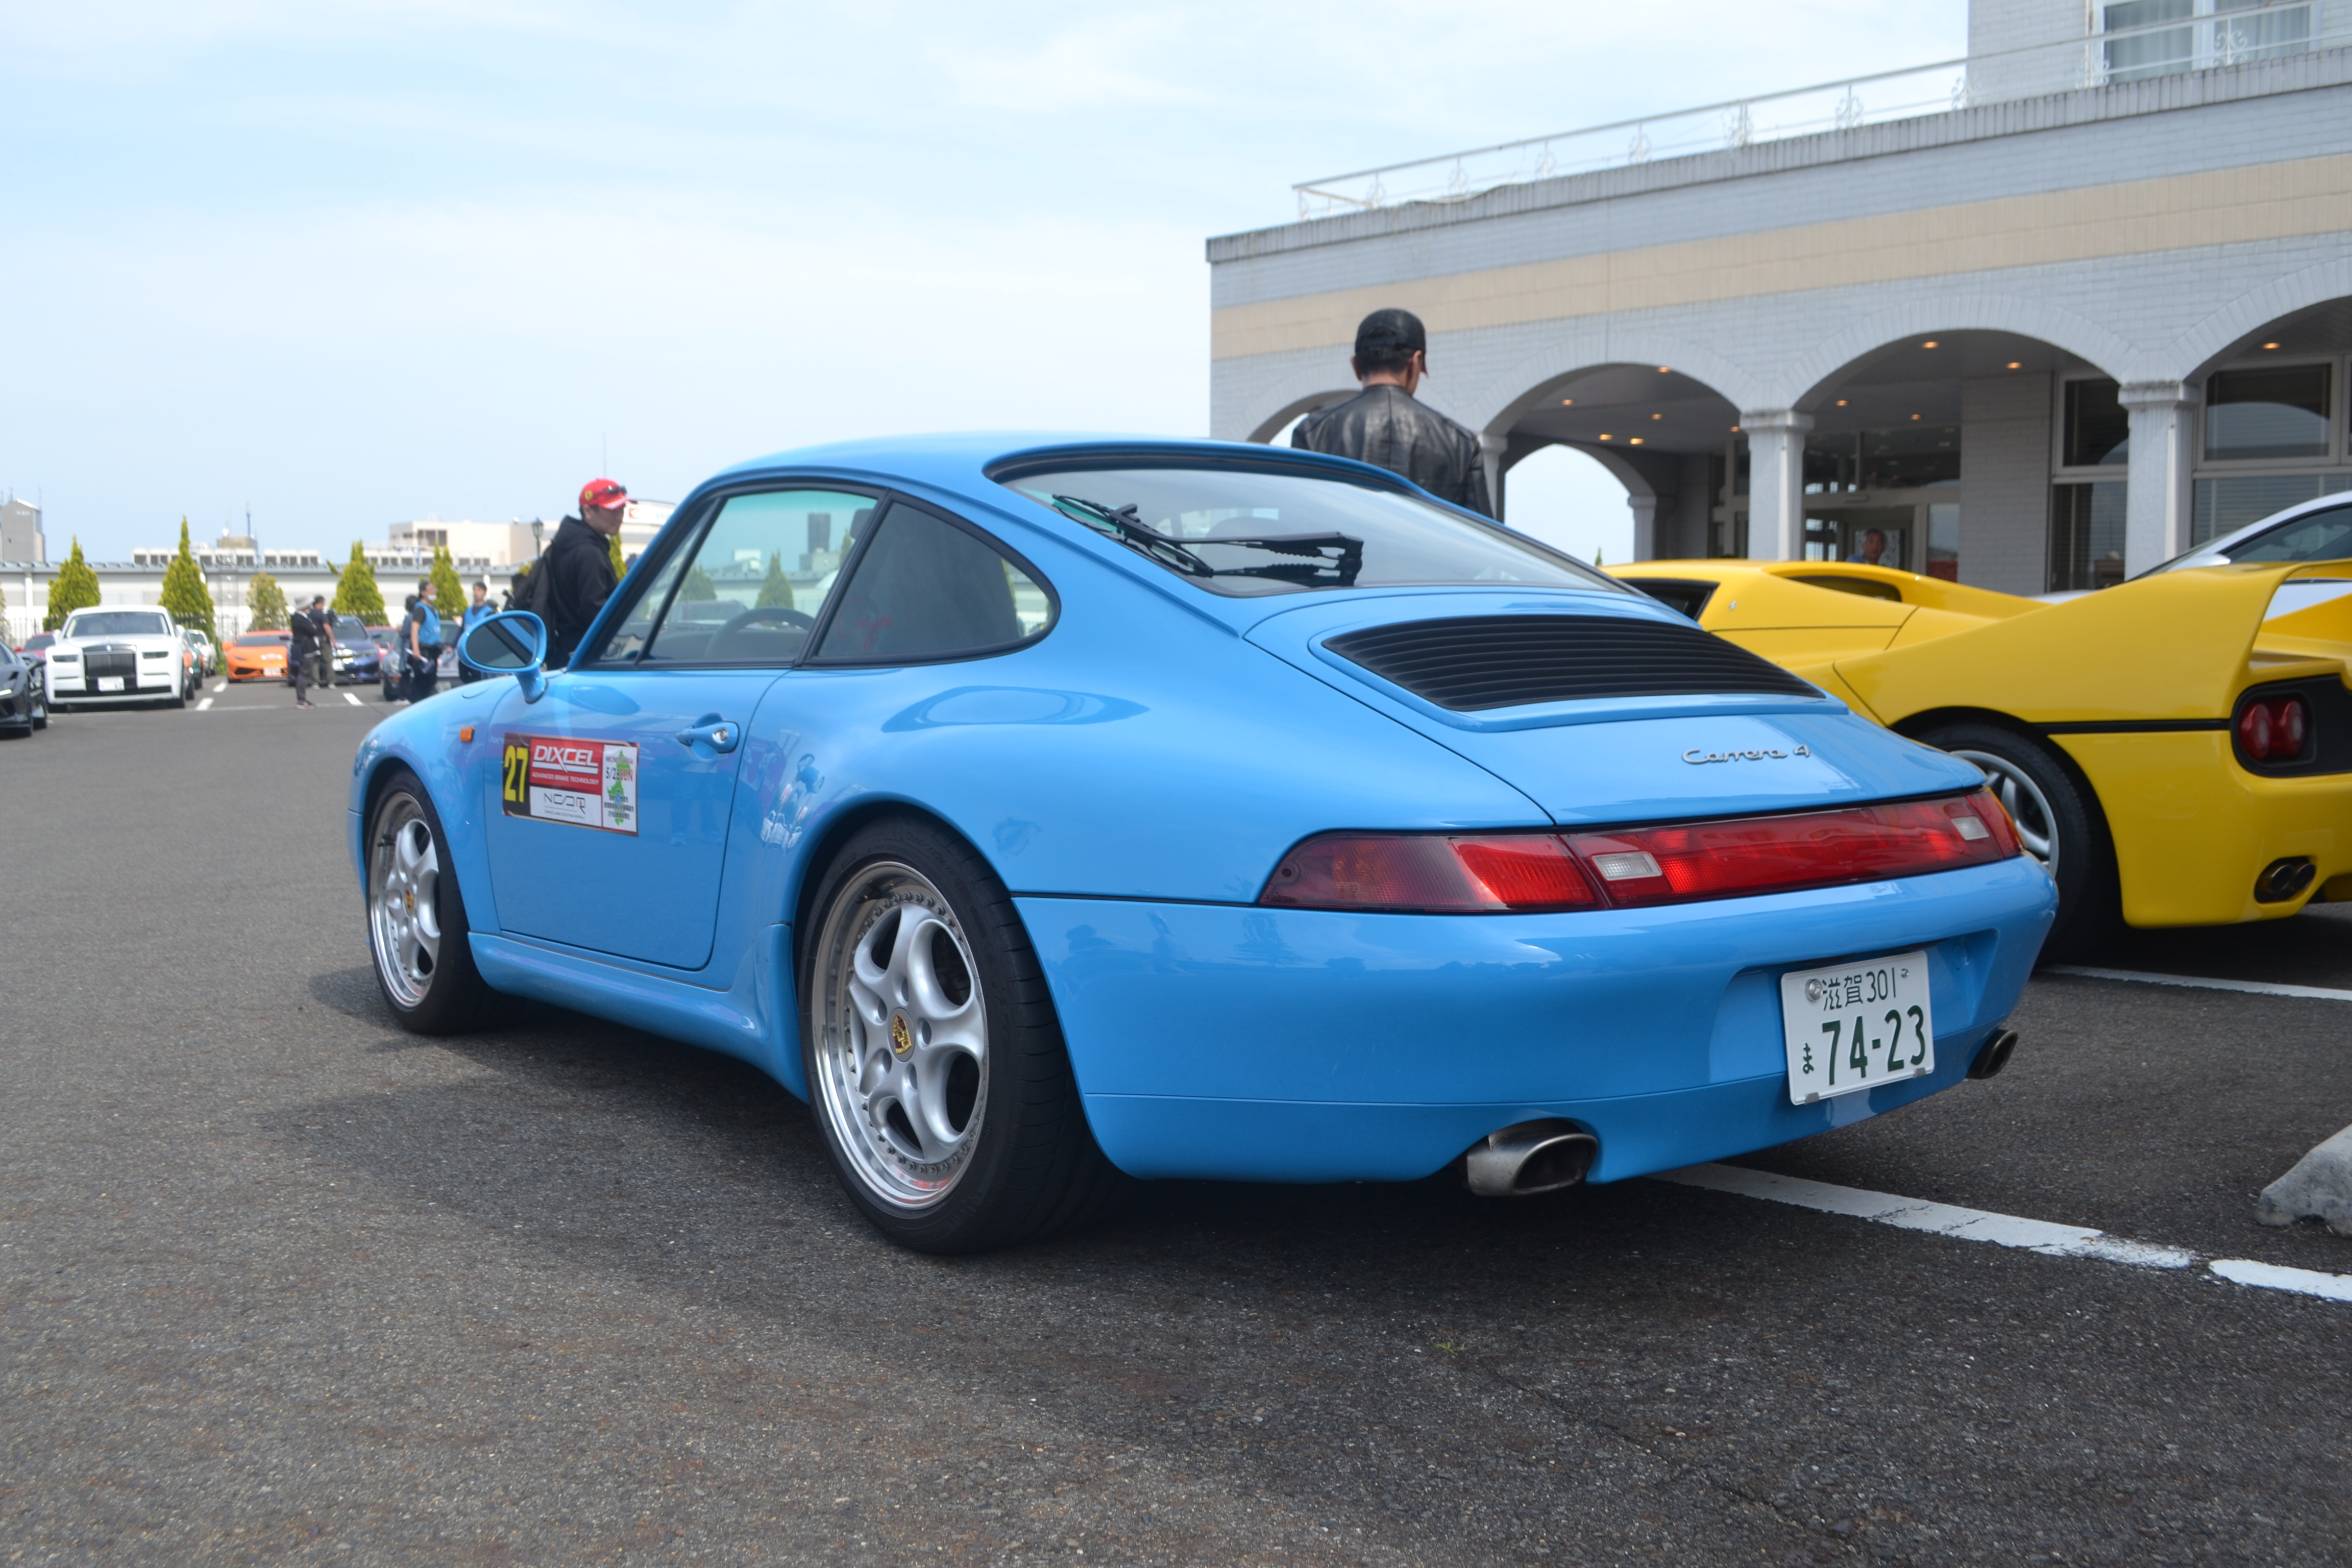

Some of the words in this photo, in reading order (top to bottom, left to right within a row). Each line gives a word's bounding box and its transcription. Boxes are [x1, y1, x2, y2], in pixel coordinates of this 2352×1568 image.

[533, 745, 599, 773] DIXCEL
[1682, 748, 1788, 765] Carrera
[1793, 744, 1811, 758] 4
[505, 745, 529, 803] 27
[532, 772, 554, 780] ADVANCED
[570, 776, 599, 785] TECHNOLOGY
[1822, 974, 1863, 1011] 滋賀
[1866, 967, 1896, 1002] 301
[1803, 1043, 1814, 1074] ま
[1822, 1005, 1926, 1086] 74-23
